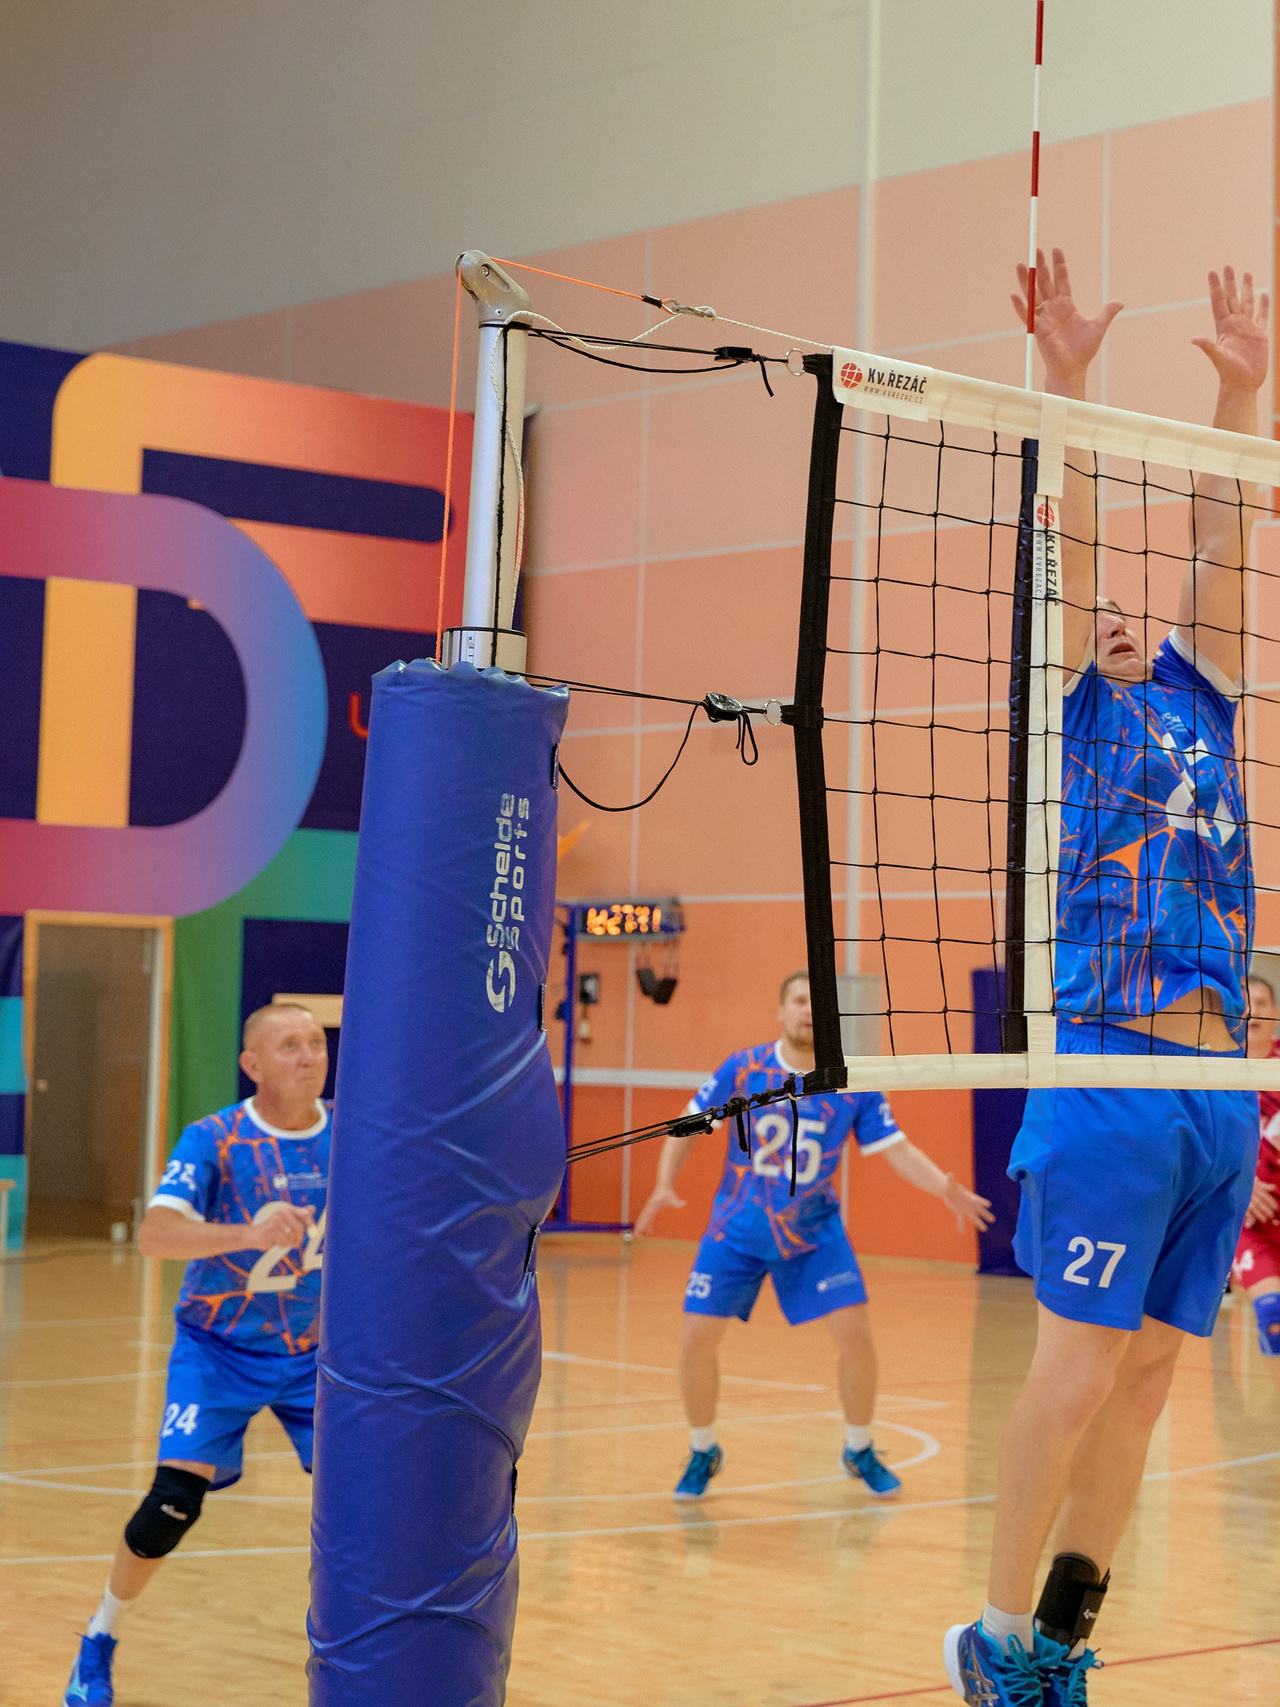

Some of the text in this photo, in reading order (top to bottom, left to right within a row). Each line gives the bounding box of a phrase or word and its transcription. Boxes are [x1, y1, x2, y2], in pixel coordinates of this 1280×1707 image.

[486, 793, 515, 948] Schelde
[161, 1159, 198, 1192] 24
[753, 1113, 827, 1185] 25
[1062, 1236, 1127, 1289] 27
[161, 1402, 199, 1438] 24
